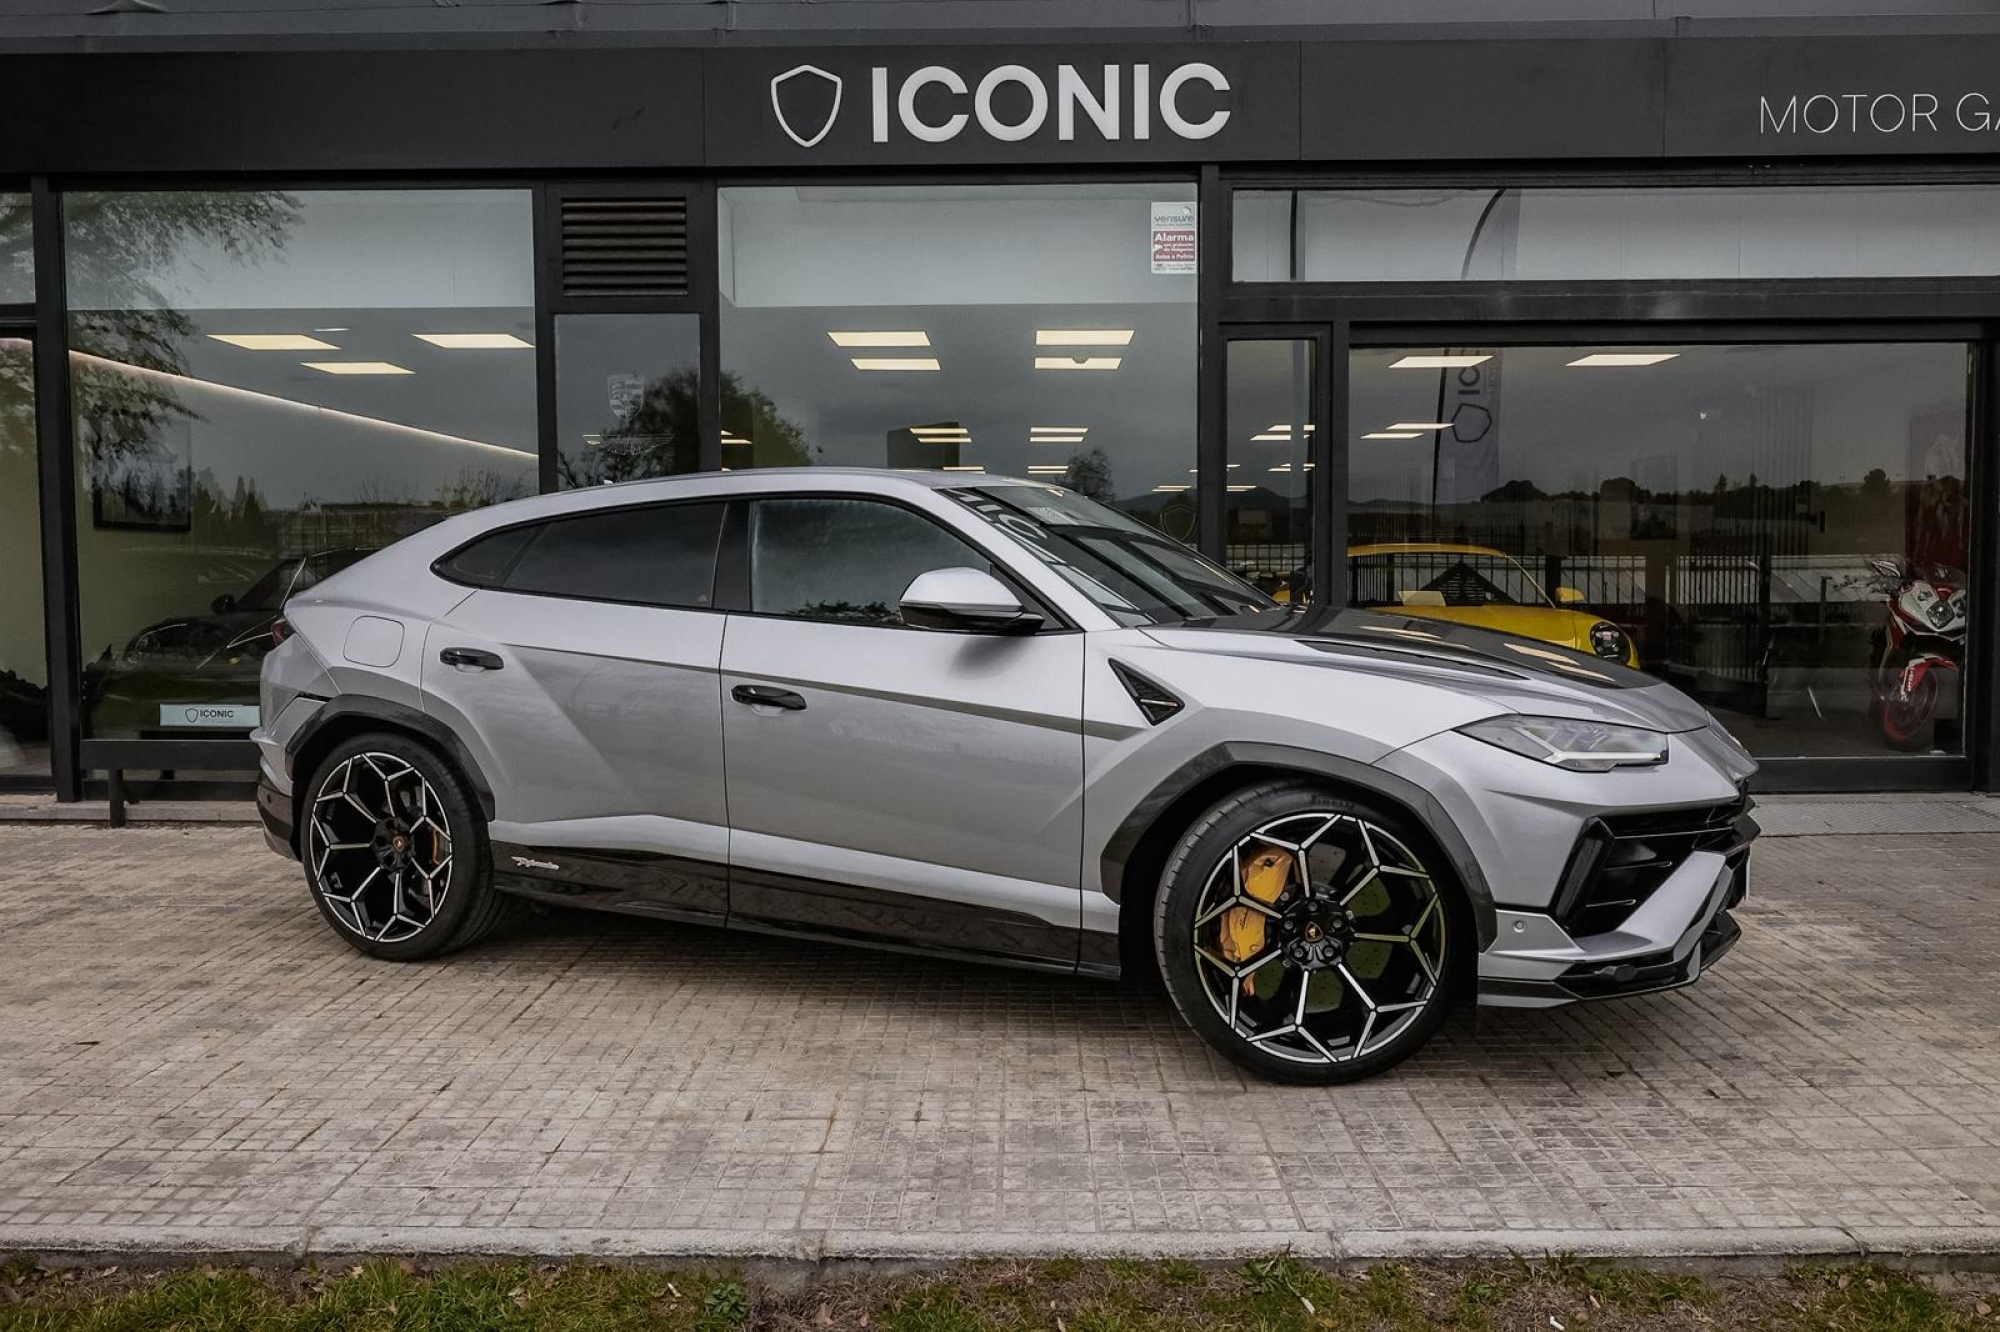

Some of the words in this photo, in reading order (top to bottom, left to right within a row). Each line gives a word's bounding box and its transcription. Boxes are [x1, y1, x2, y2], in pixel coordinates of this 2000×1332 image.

[872, 62, 1231, 143] ICONIC
[1760, 93, 1939, 134] MOTOR
[1956, 92, 2000, 132] G
[1154, 232, 1195, 242] Alarma
[200, 709, 234, 718] ICONIC
